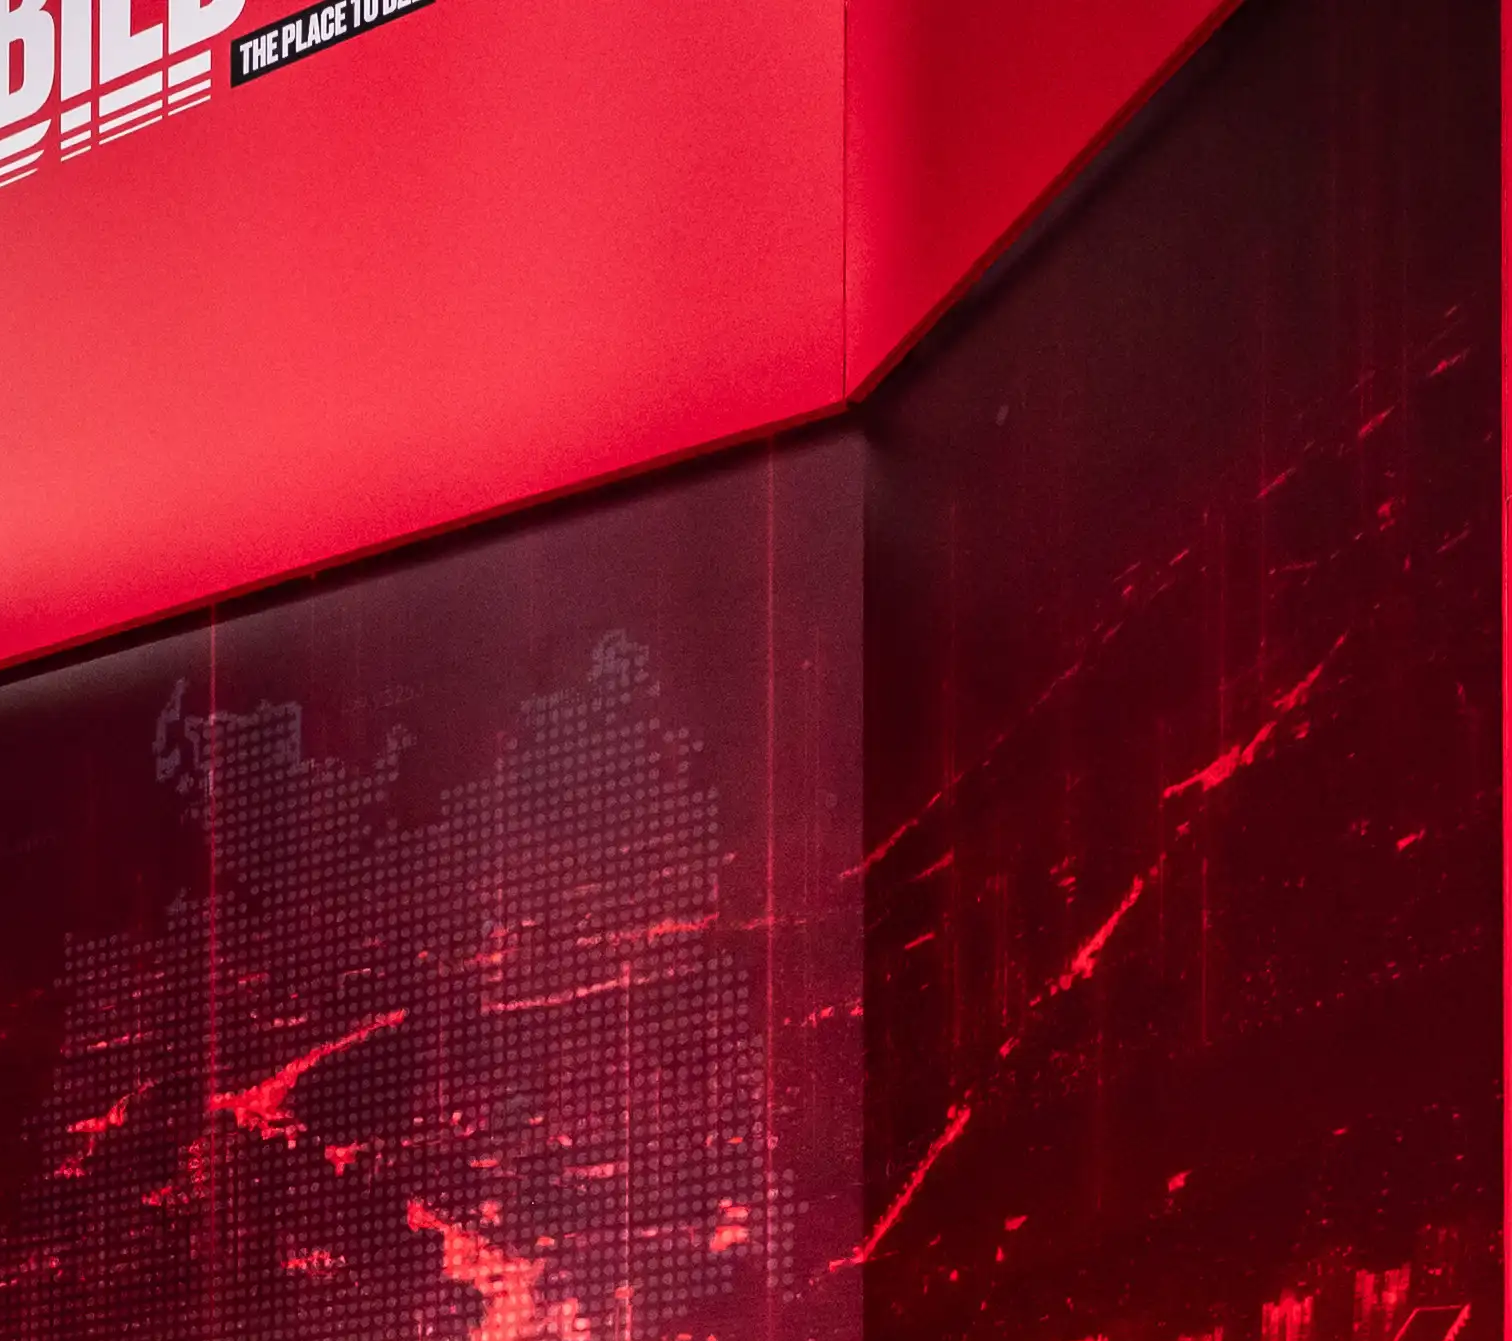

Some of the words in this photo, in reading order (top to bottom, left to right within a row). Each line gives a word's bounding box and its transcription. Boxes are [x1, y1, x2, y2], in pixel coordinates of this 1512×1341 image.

[239, 30, 279, 75] THE
[281, 7, 347, 58] PLACE
[351, 0, 379, 28] TO
